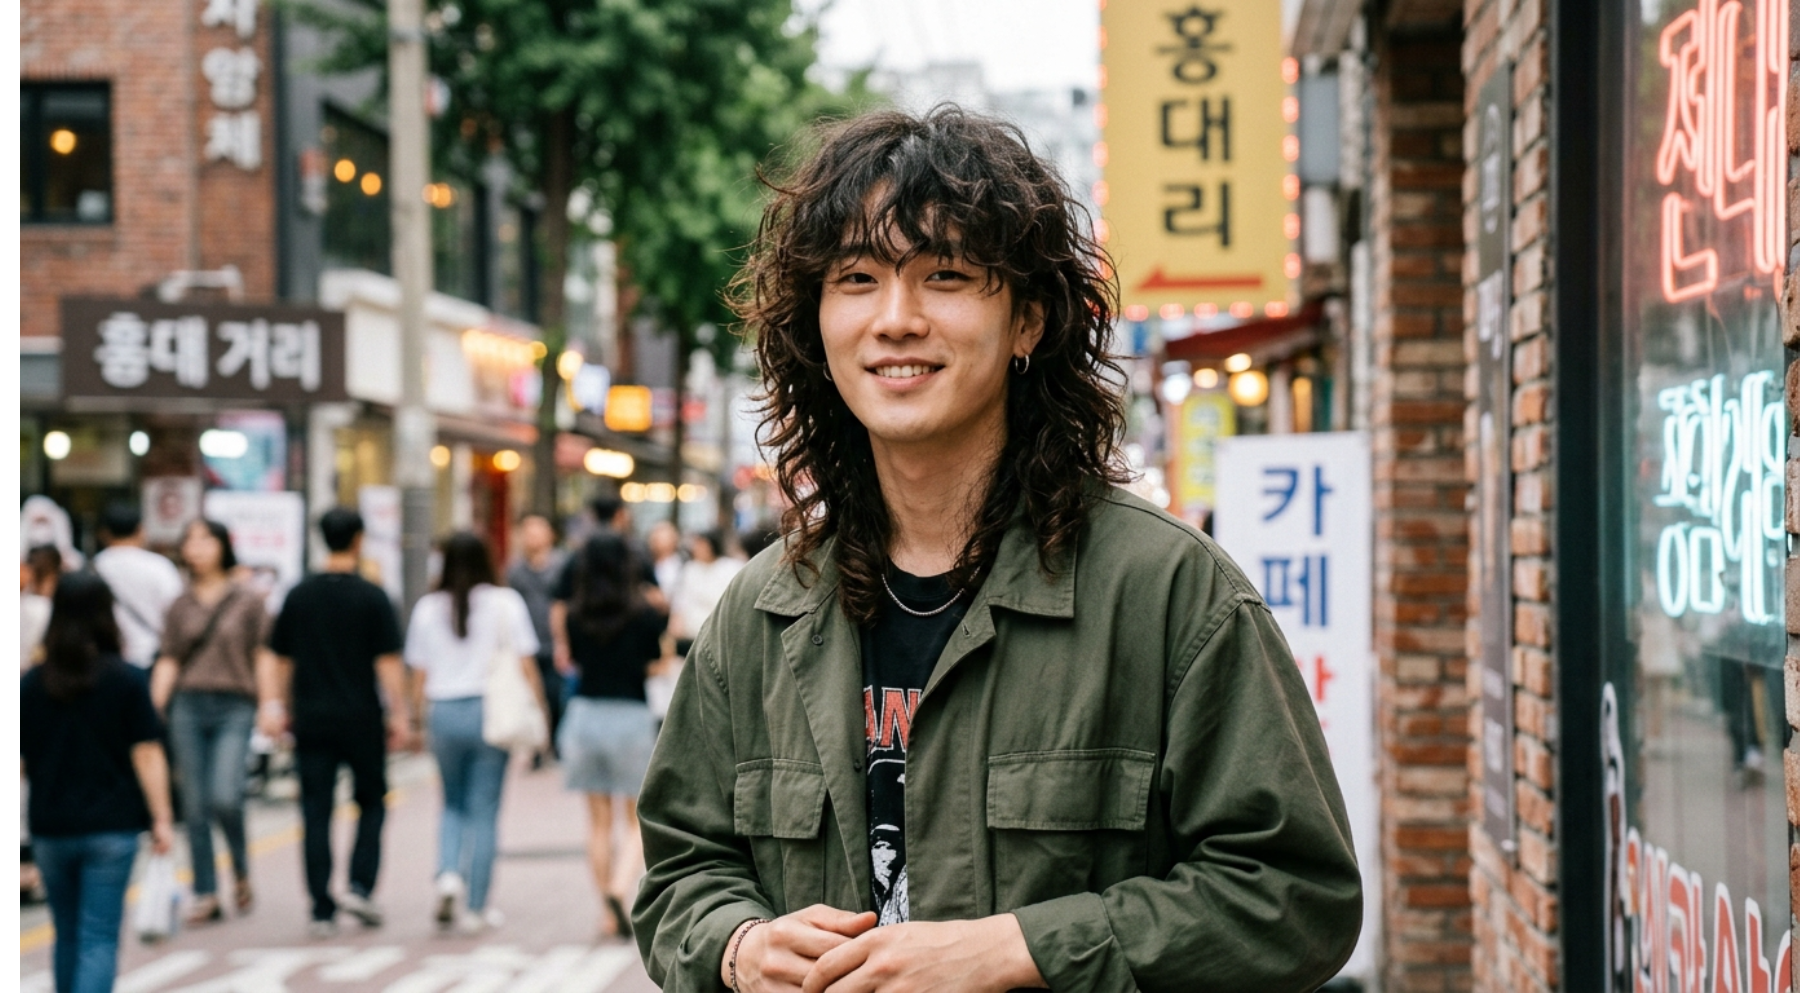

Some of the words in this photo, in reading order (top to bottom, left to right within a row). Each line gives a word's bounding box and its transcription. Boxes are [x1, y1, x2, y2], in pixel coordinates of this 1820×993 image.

[1156, 6, 1232, 249] 홍대리
[94, 312, 208, 389] 홍대
[216, 318, 321, 392] 거리
[1262, 466, 1335, 628] 카페
